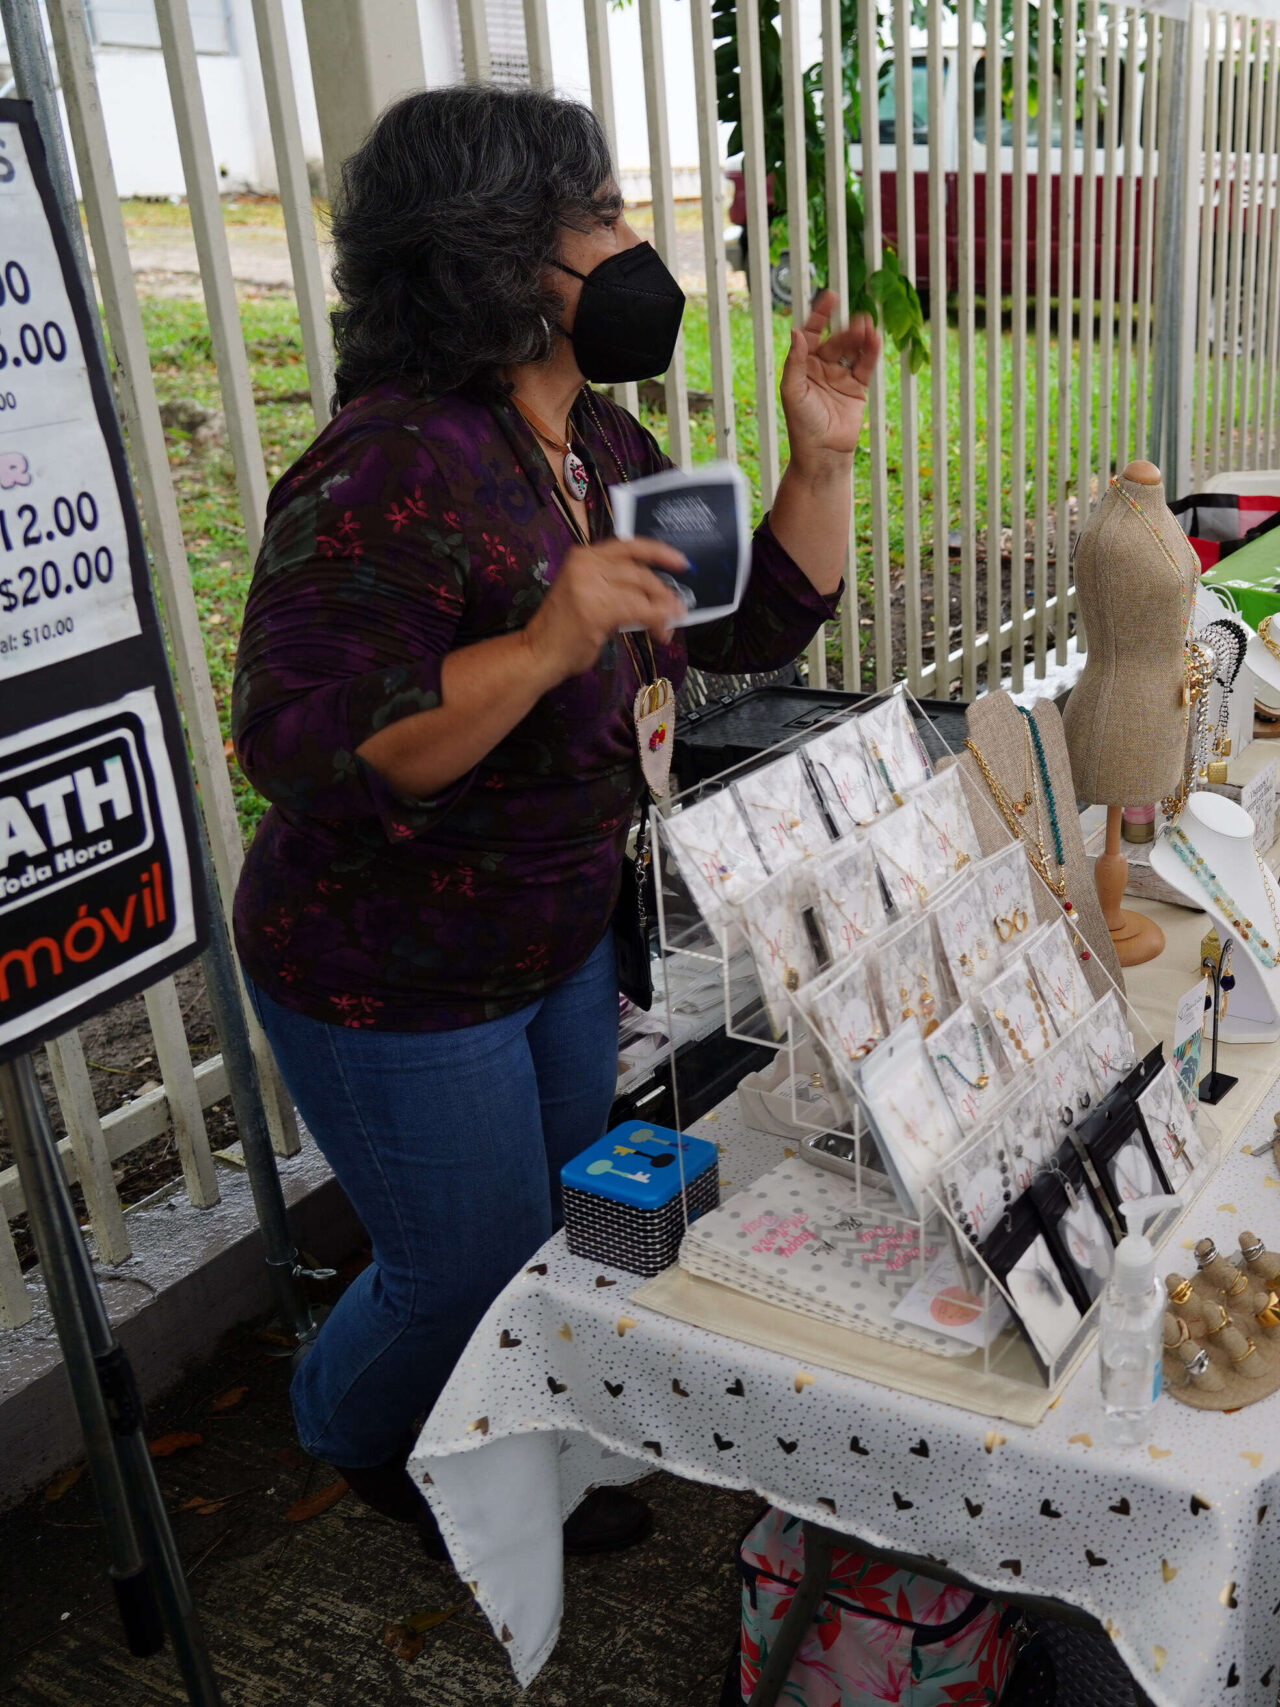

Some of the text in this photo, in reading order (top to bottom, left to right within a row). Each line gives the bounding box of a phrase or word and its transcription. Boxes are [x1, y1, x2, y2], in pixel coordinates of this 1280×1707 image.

[0, 546, 113, 612] $20.00
[23, 616, 74, 647] $10.00
[0, 755, 133, 870] ATH
[54, 839, 113, 873] Hora
[0, 862, 166, 1001] móvil
